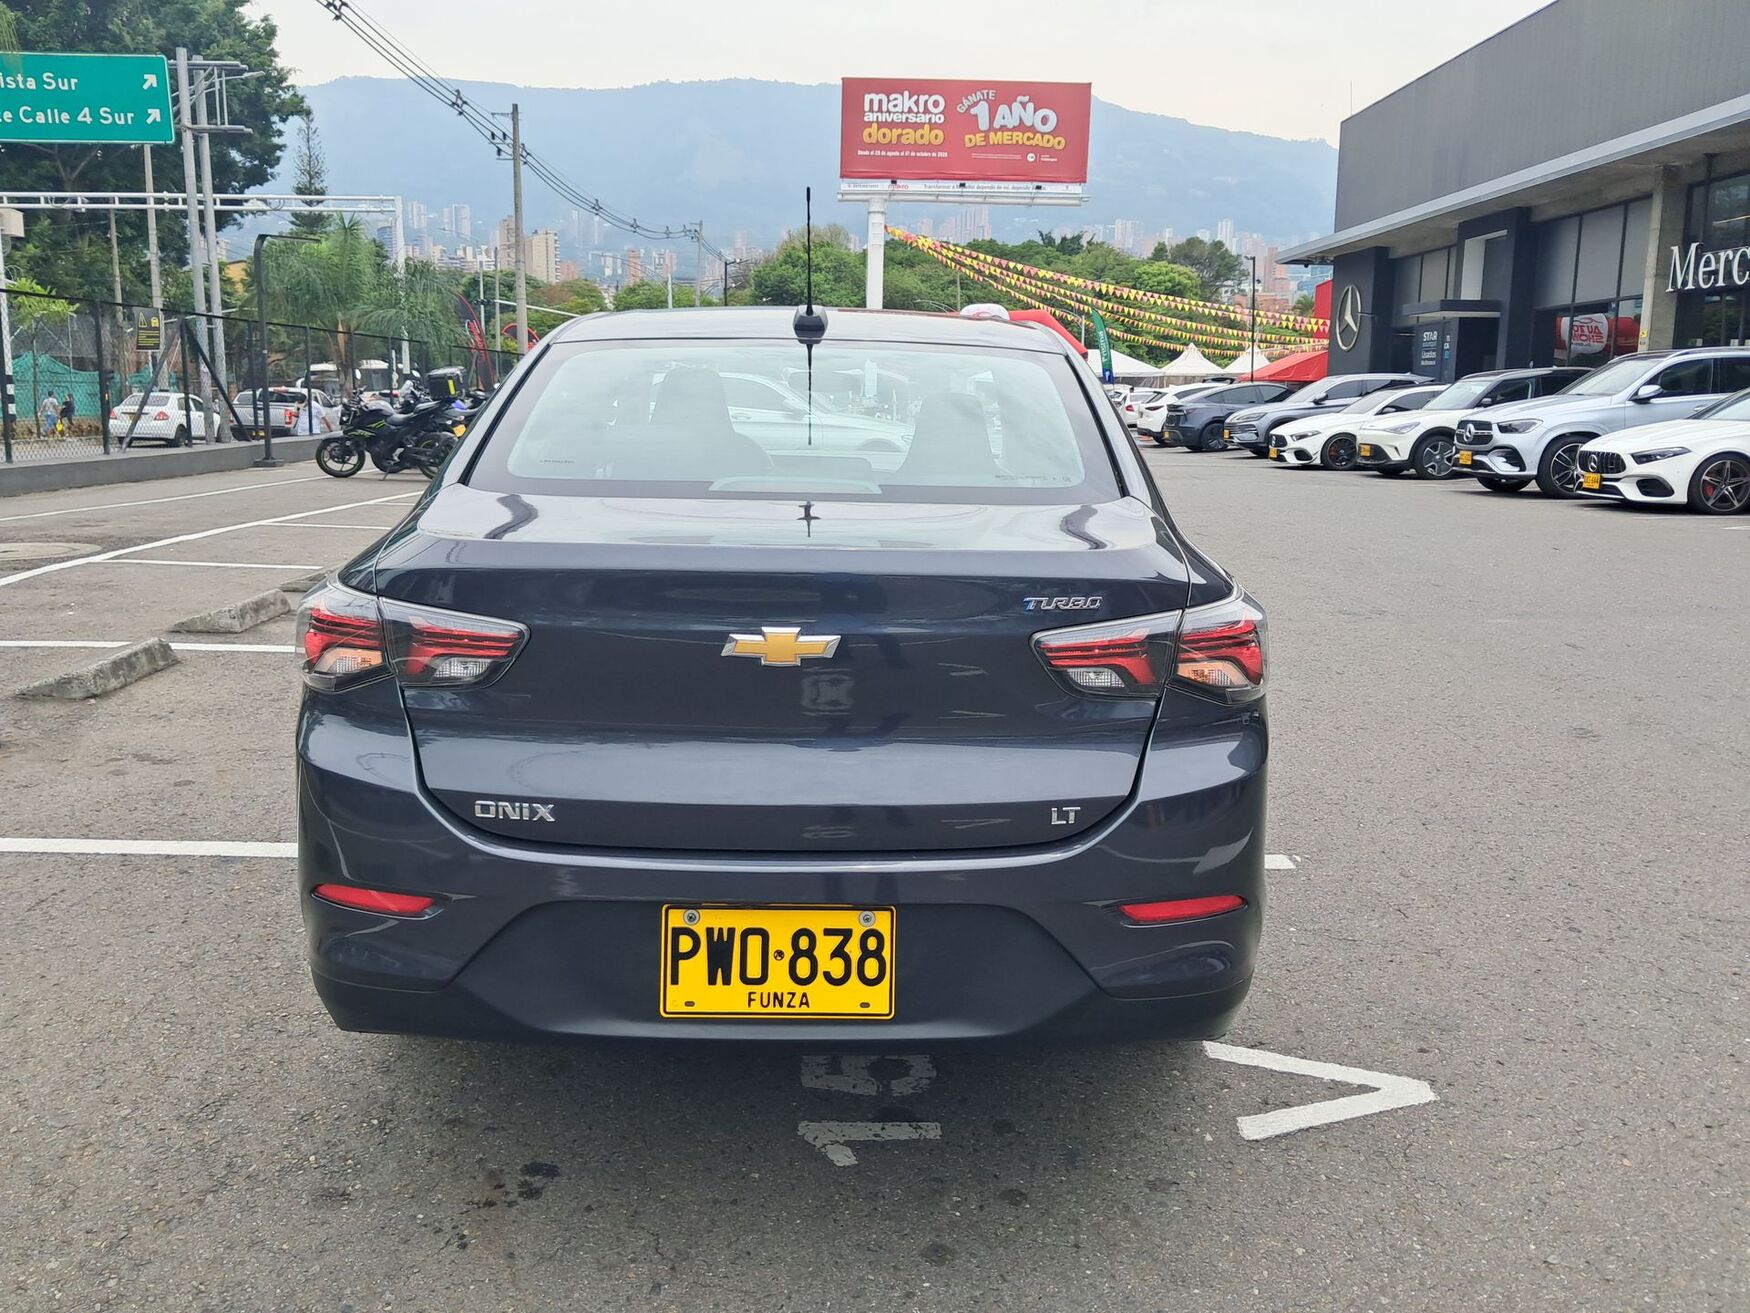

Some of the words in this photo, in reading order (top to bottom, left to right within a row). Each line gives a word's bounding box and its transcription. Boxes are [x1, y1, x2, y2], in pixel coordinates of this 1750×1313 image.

[43, 72, 78, 90] Sur
[864, 90, 945, 113] makro
[19, 106, 70, 124] Calle
[77, 107, 93, 124] 4
[99, 107, 134, 125] Sur
[864, 111, 945, 124] aniversario
[970, 101, 990, 131] 1
[993, 95, 1057, 133] AÑO
[863, 122, 945, 146] dorado
[964, 133, 986, 148] DE
[989, 131, 1067, 150] MERCADO
[1665, 242, 1750, 292] Merc
[1023, 596, 1103, 610] TURBO
[474, 800, 556, 822] ONIX
[1051, 806, 1081, 825] LT
[747, 992, 810, 1008] FUNZA
